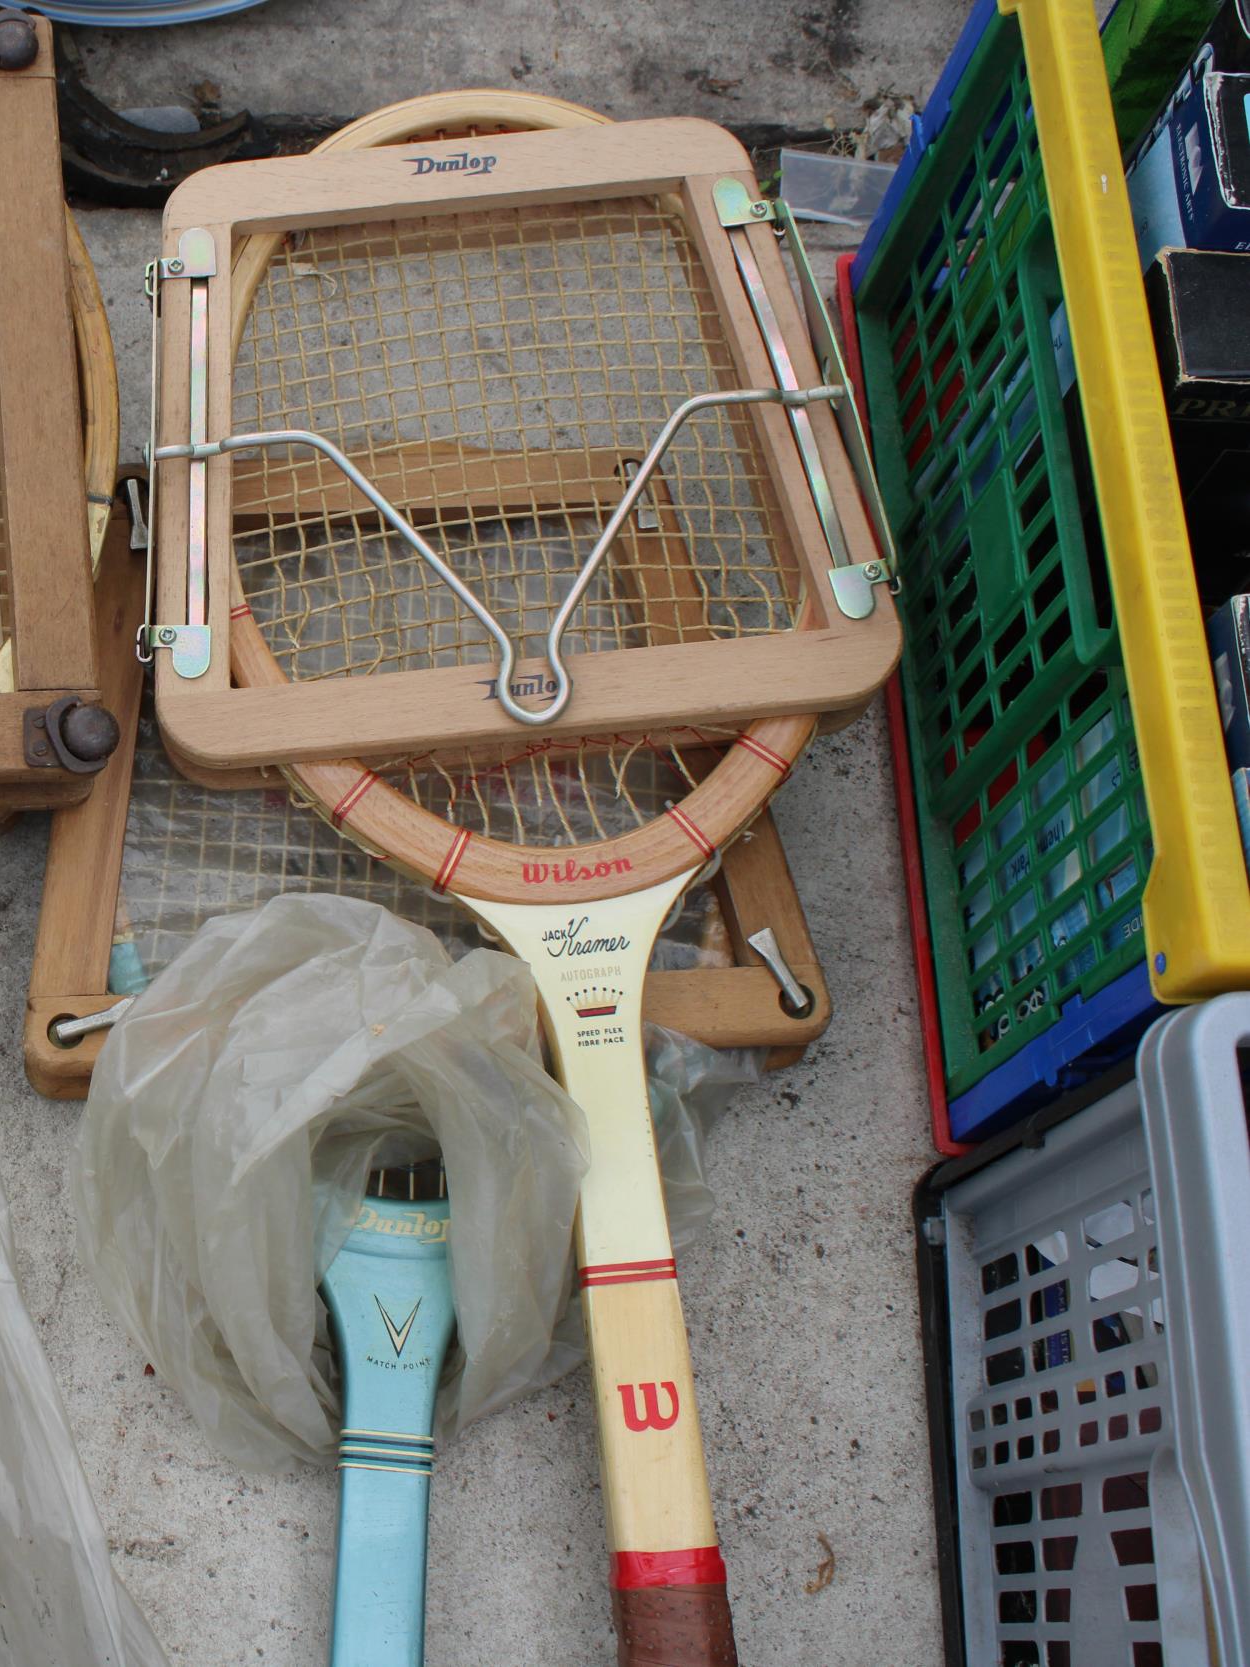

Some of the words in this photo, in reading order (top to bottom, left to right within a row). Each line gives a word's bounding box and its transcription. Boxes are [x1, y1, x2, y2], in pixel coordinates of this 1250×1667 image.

[401, 152, 497, 176] Dunlop
[473, 673, 573, 702] Dunlo
[522, 857, 633, 884] Wilson
[542, 928, 567, 942] JACK
[547, 916, 630, 958] Kramer
[560, 965, 622, 983] AUTOGRAPH
[576, 1029, 600, 1038] SPEED
[604, 1027, 623, 1035] FLEX
[366, 1355, 397, 1370] MATCH
[403, 1357, 431, 1371] POINT
